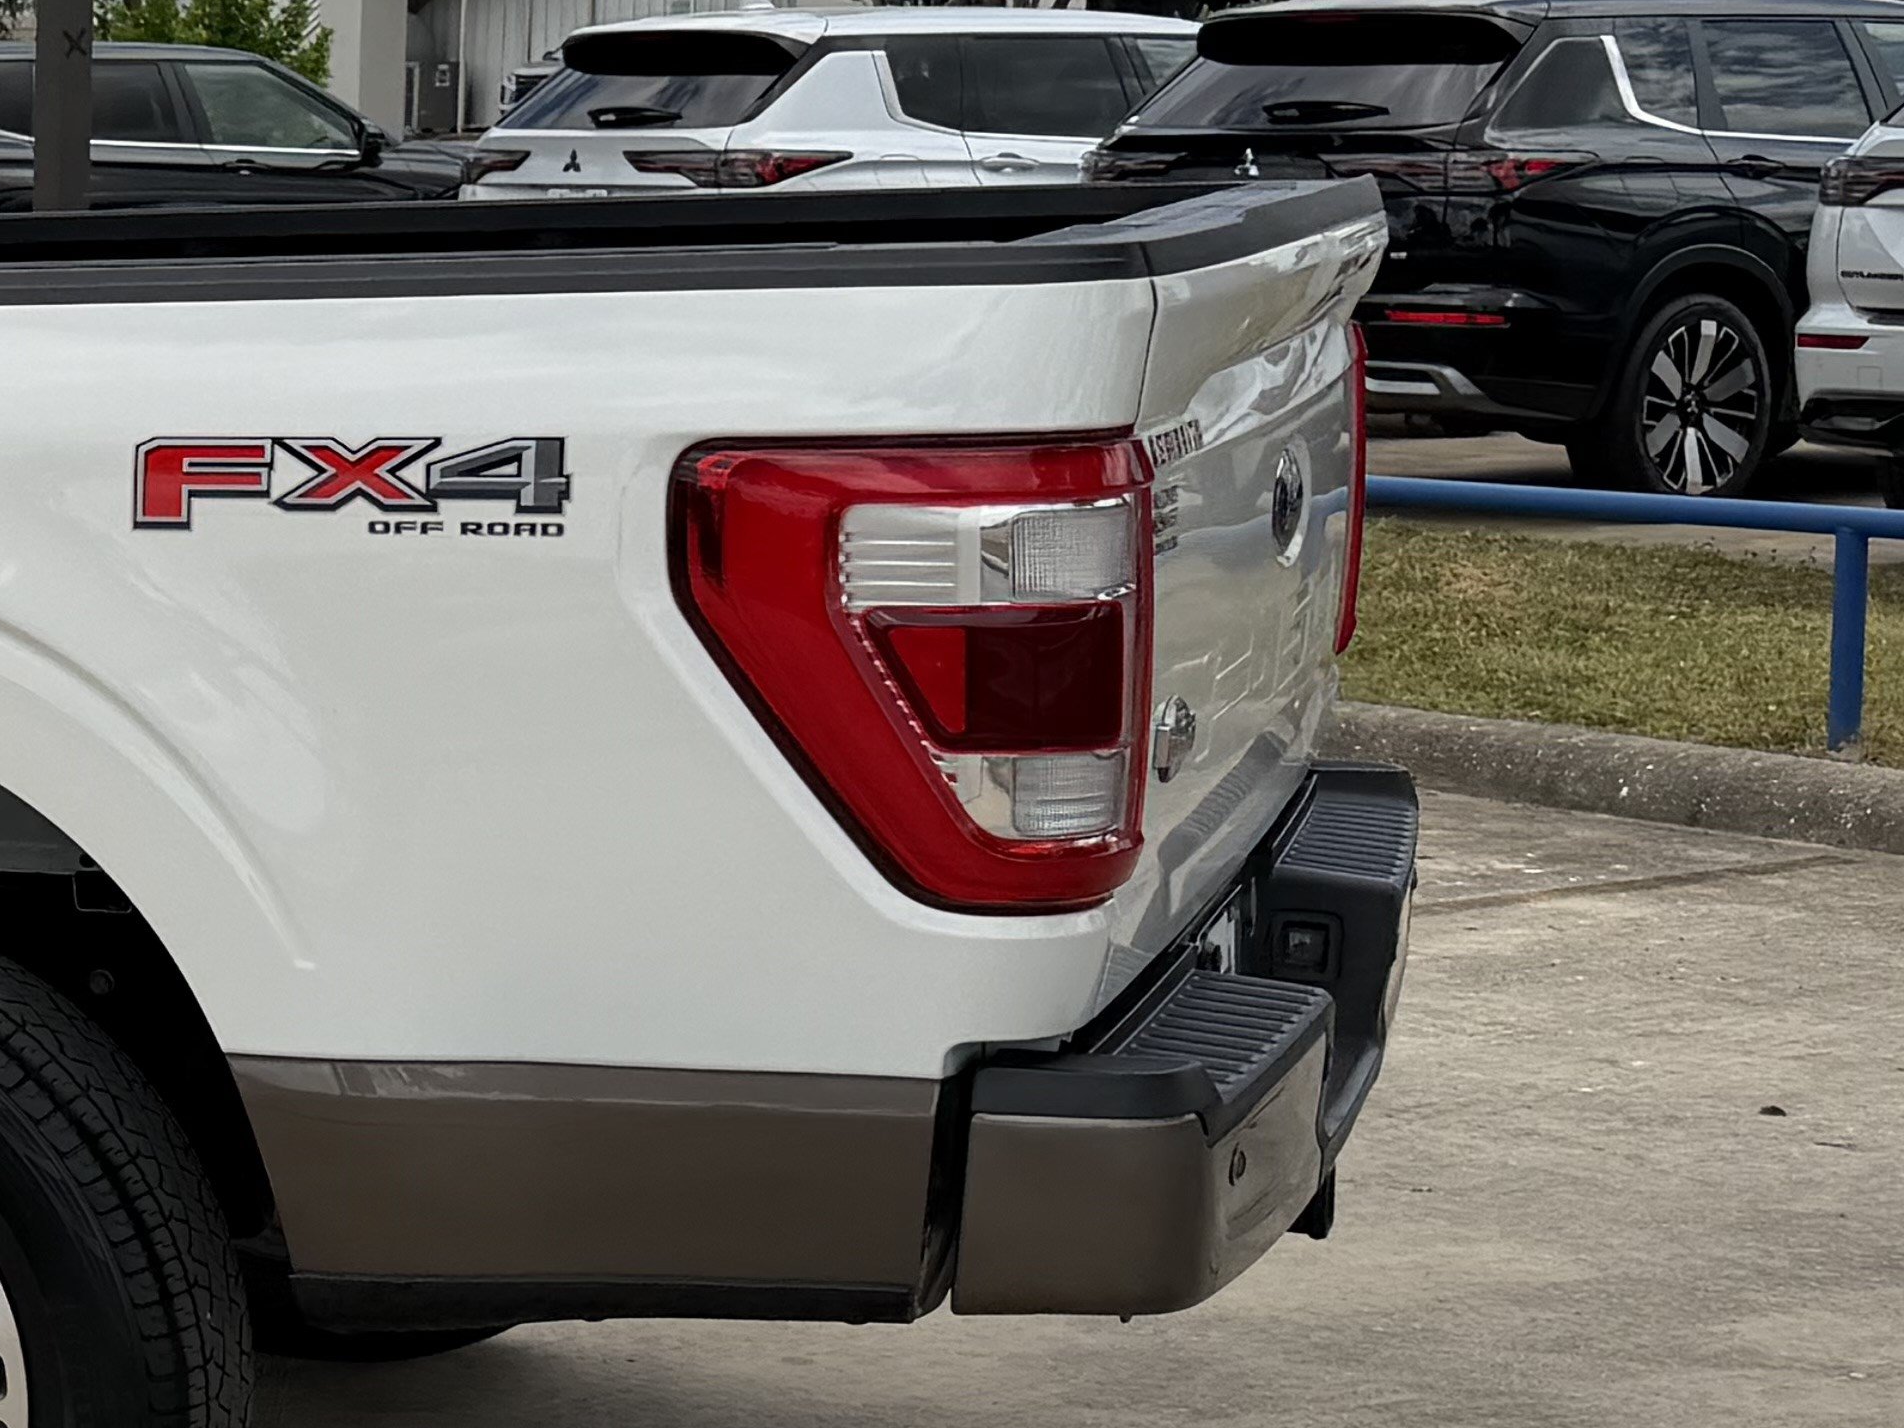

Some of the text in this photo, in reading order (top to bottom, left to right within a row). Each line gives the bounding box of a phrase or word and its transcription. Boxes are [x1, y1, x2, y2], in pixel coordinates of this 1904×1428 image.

[133, 436, 572, 530] FX4
[368, 520, 565, 538] OFF ROAD
